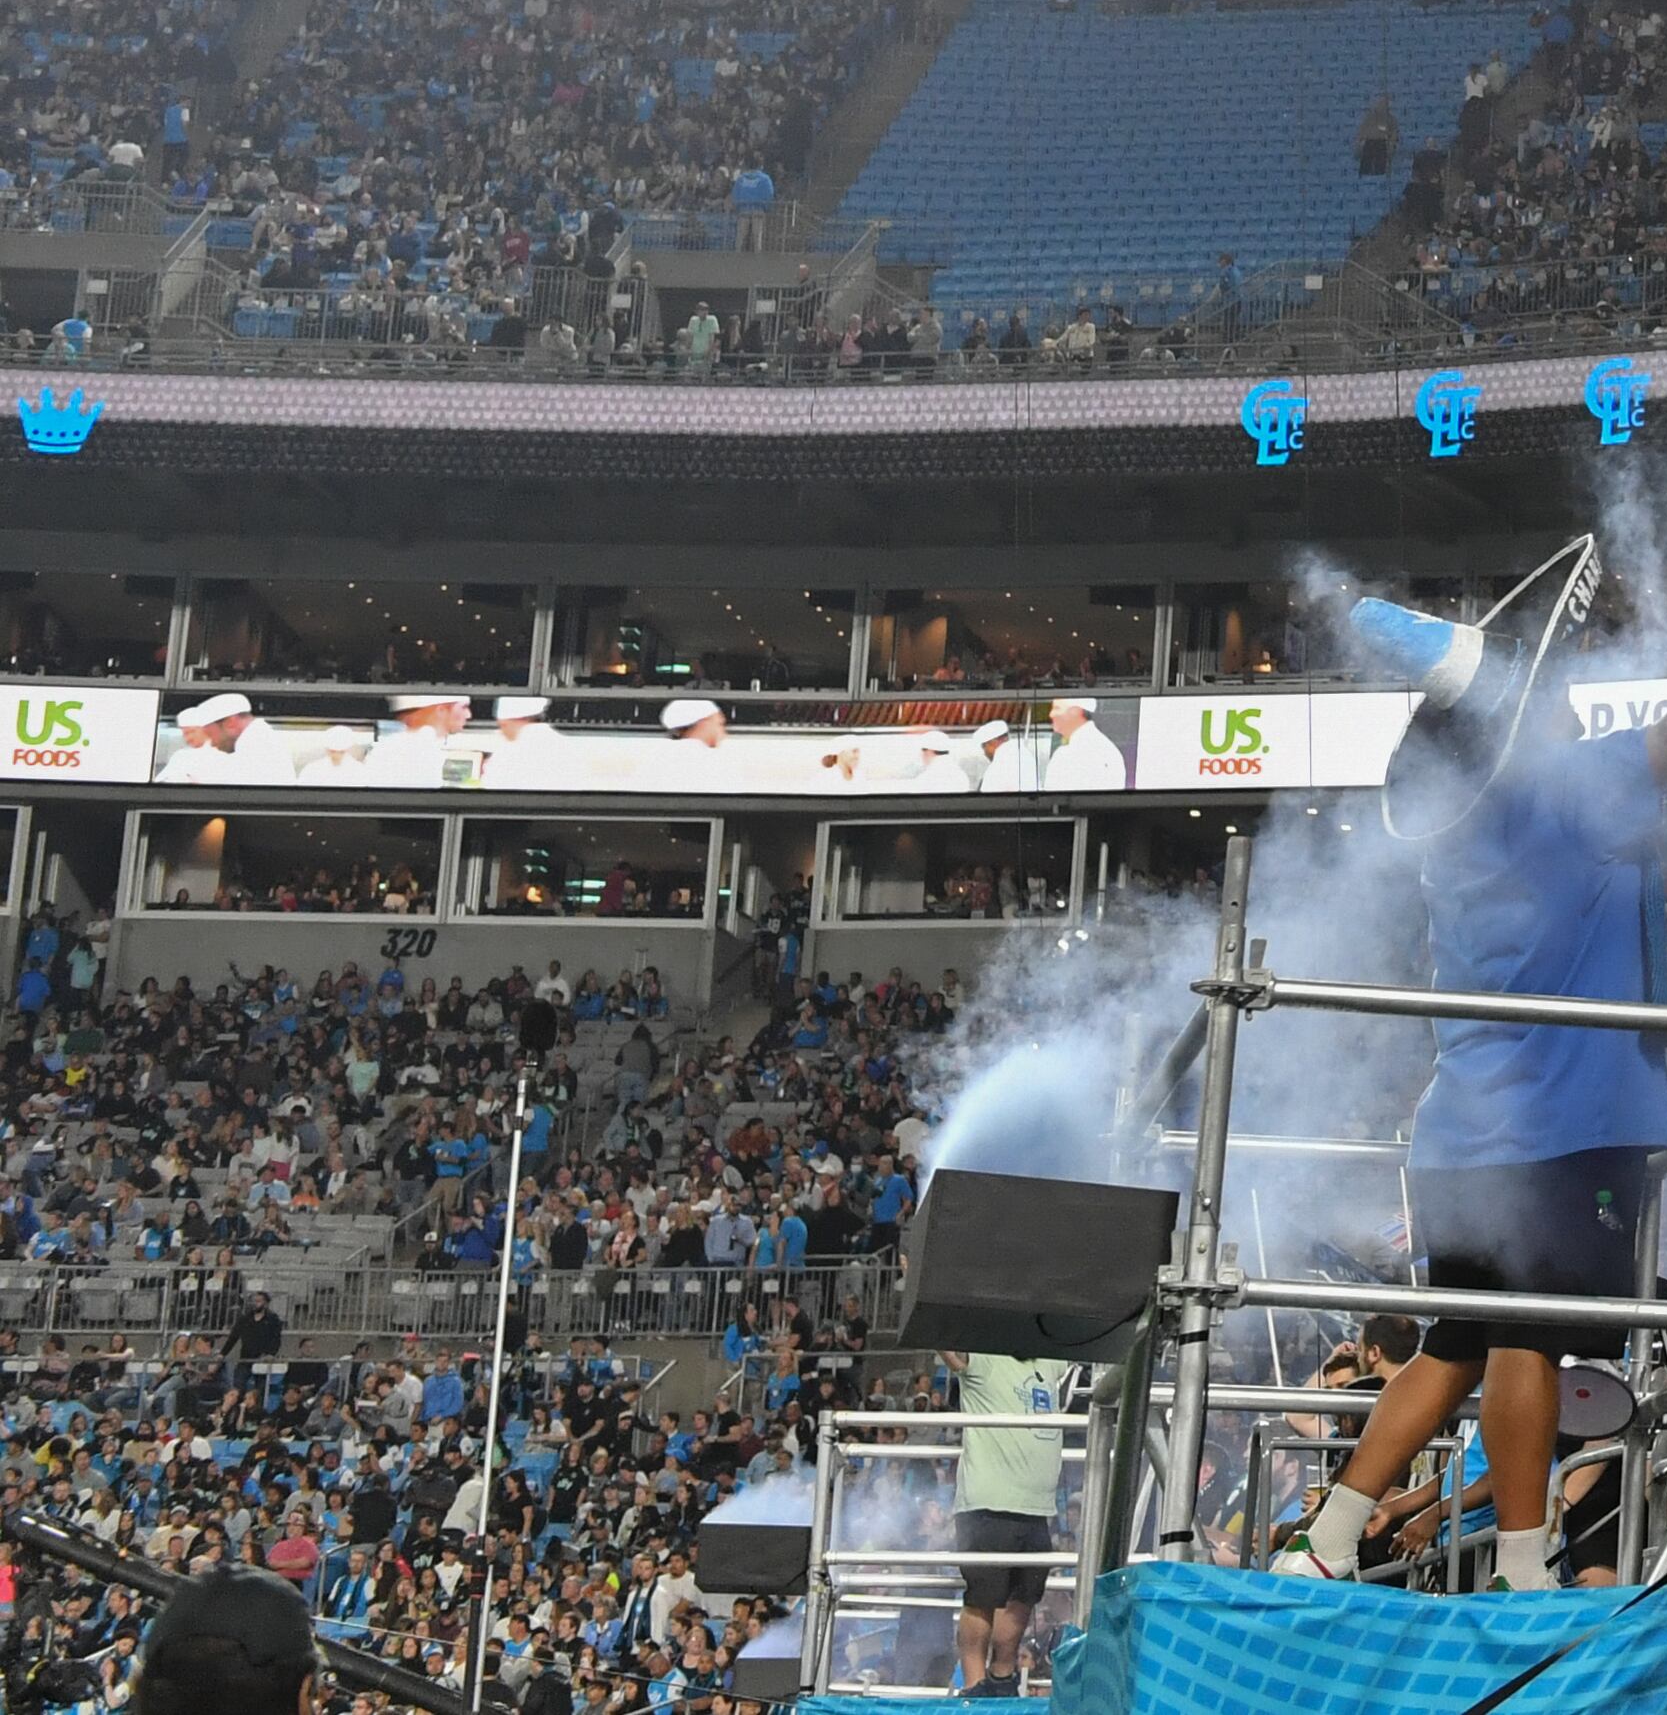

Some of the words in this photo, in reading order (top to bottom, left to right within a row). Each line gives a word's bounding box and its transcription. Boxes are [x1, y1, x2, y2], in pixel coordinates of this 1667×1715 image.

[13, 748, 81, 767] FOODS
[1199, 757, 1262, 775] FOODS
[380, 928, 437, 958] 320
